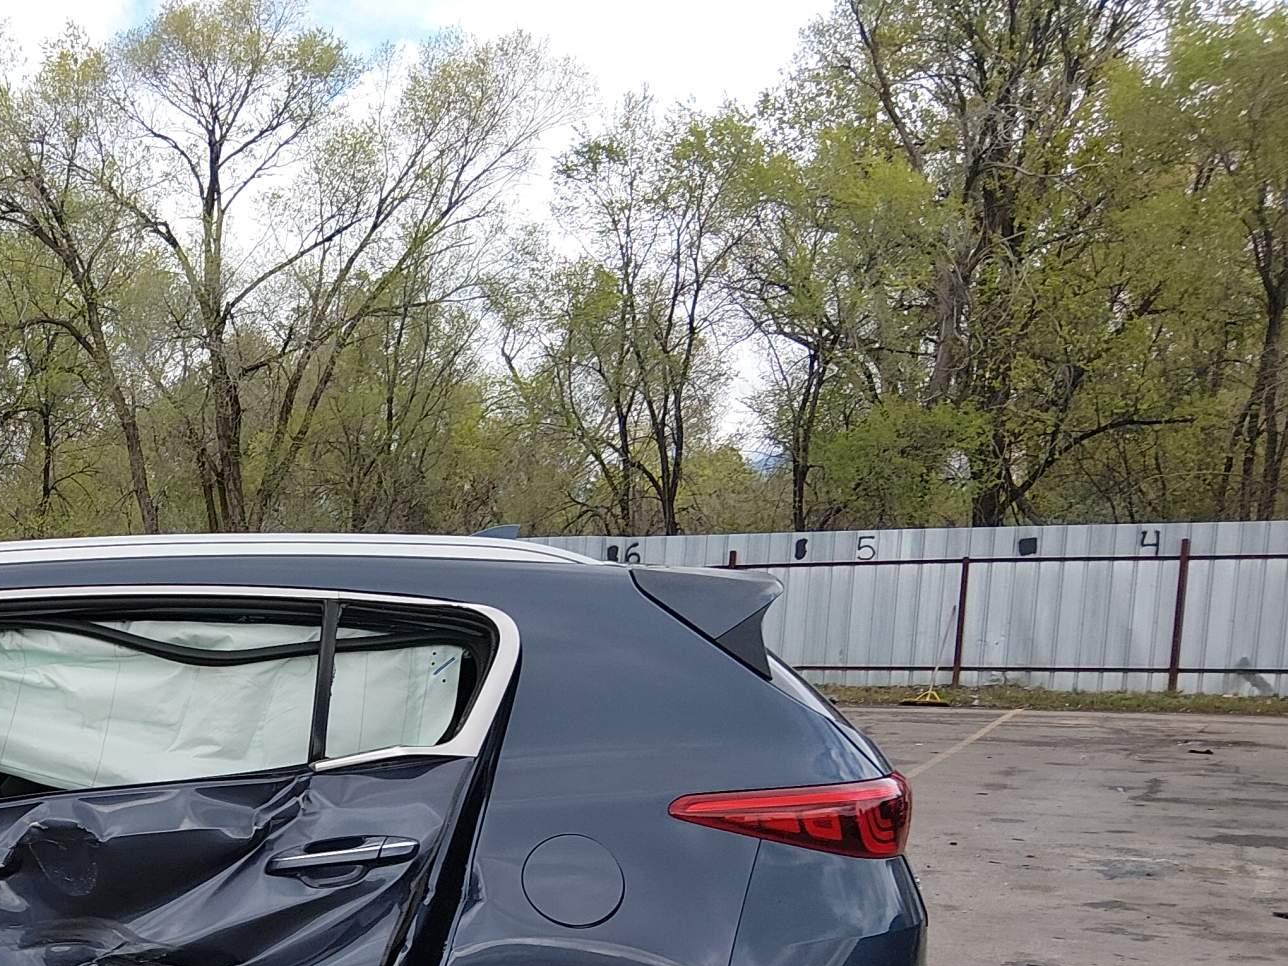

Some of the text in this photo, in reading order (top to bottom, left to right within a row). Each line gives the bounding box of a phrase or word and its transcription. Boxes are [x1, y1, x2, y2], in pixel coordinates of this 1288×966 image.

[624, 542, 640, 563] 6
[857, 535, 876, 561] 5
[1141, 530, 1160, 556] 4
